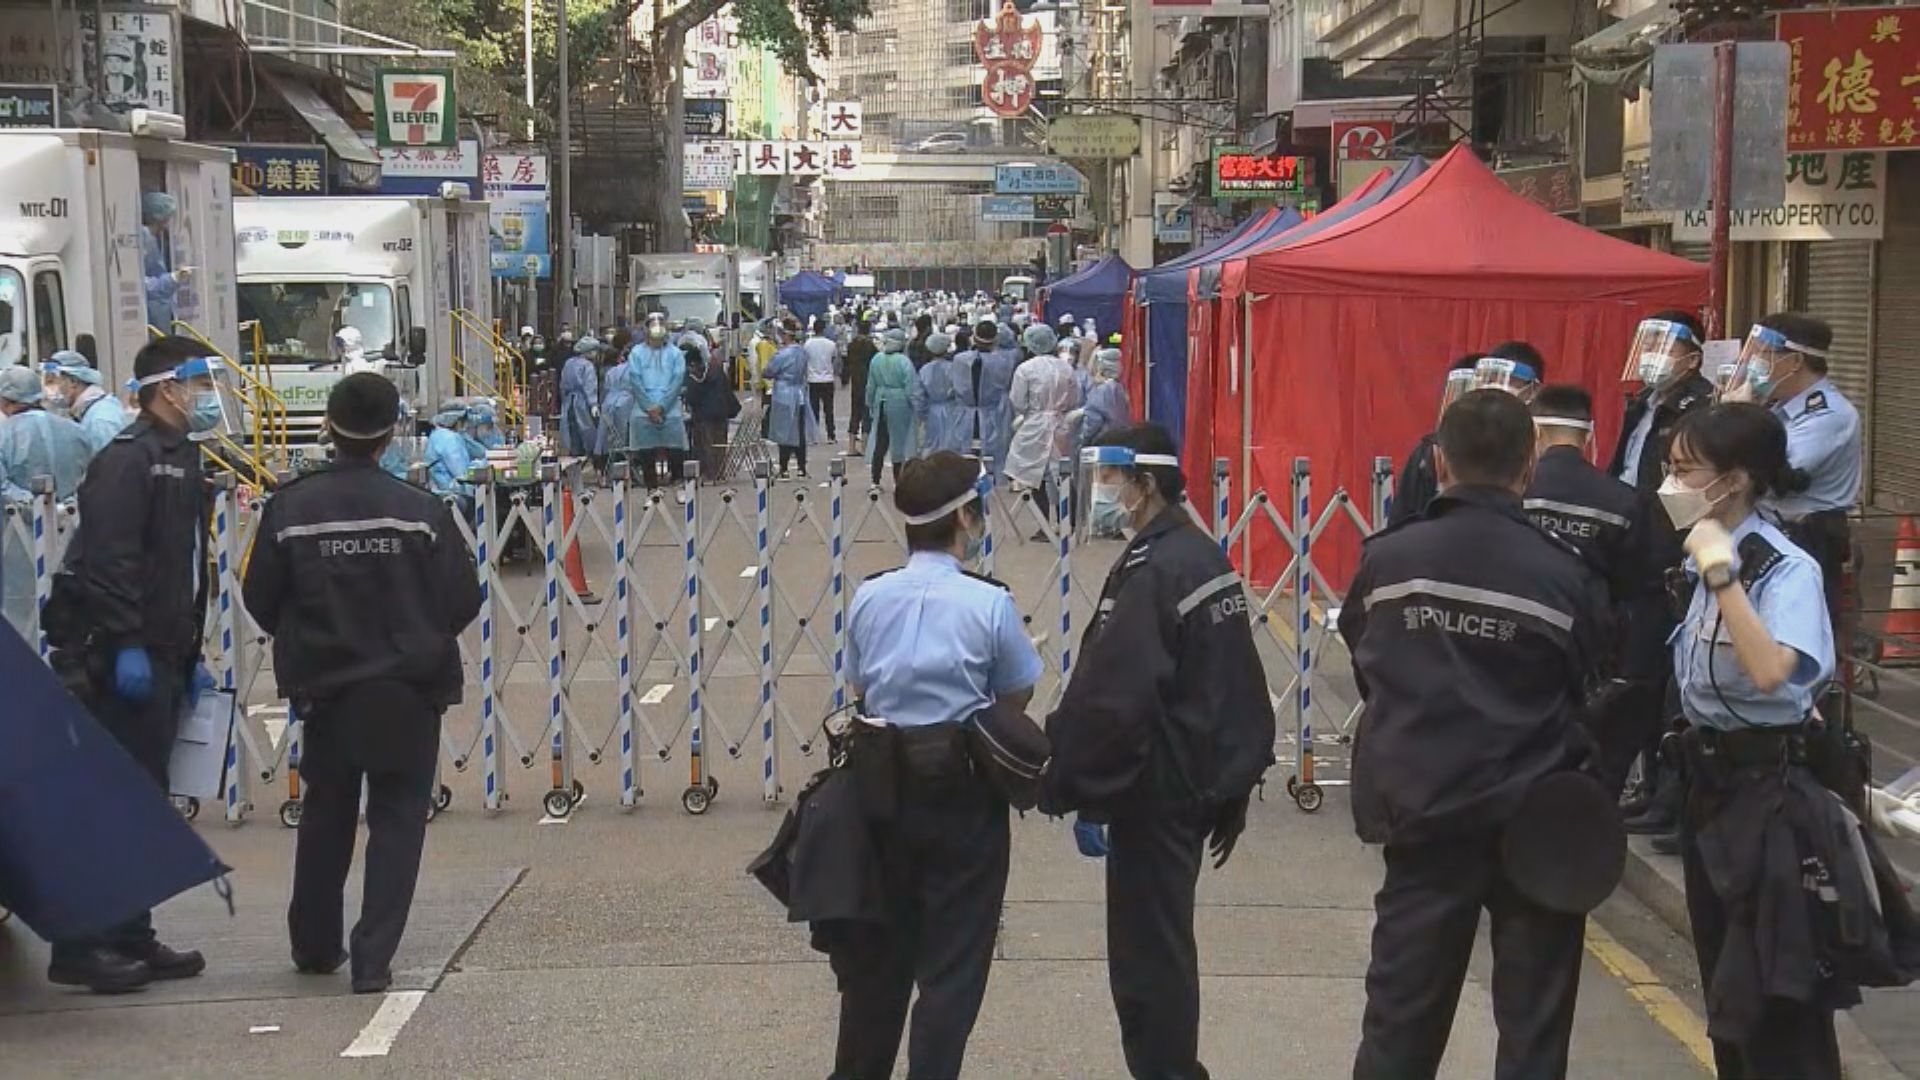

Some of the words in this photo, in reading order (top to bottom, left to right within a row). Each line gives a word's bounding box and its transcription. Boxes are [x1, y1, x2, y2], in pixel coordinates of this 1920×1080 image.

[393, 82, 438, 144] 7
[20, 198, 68, 218] MTC-01
[1750, 204, 1844, 227] PROPERTY
[1420, 605, 1498, 639] POLICE
